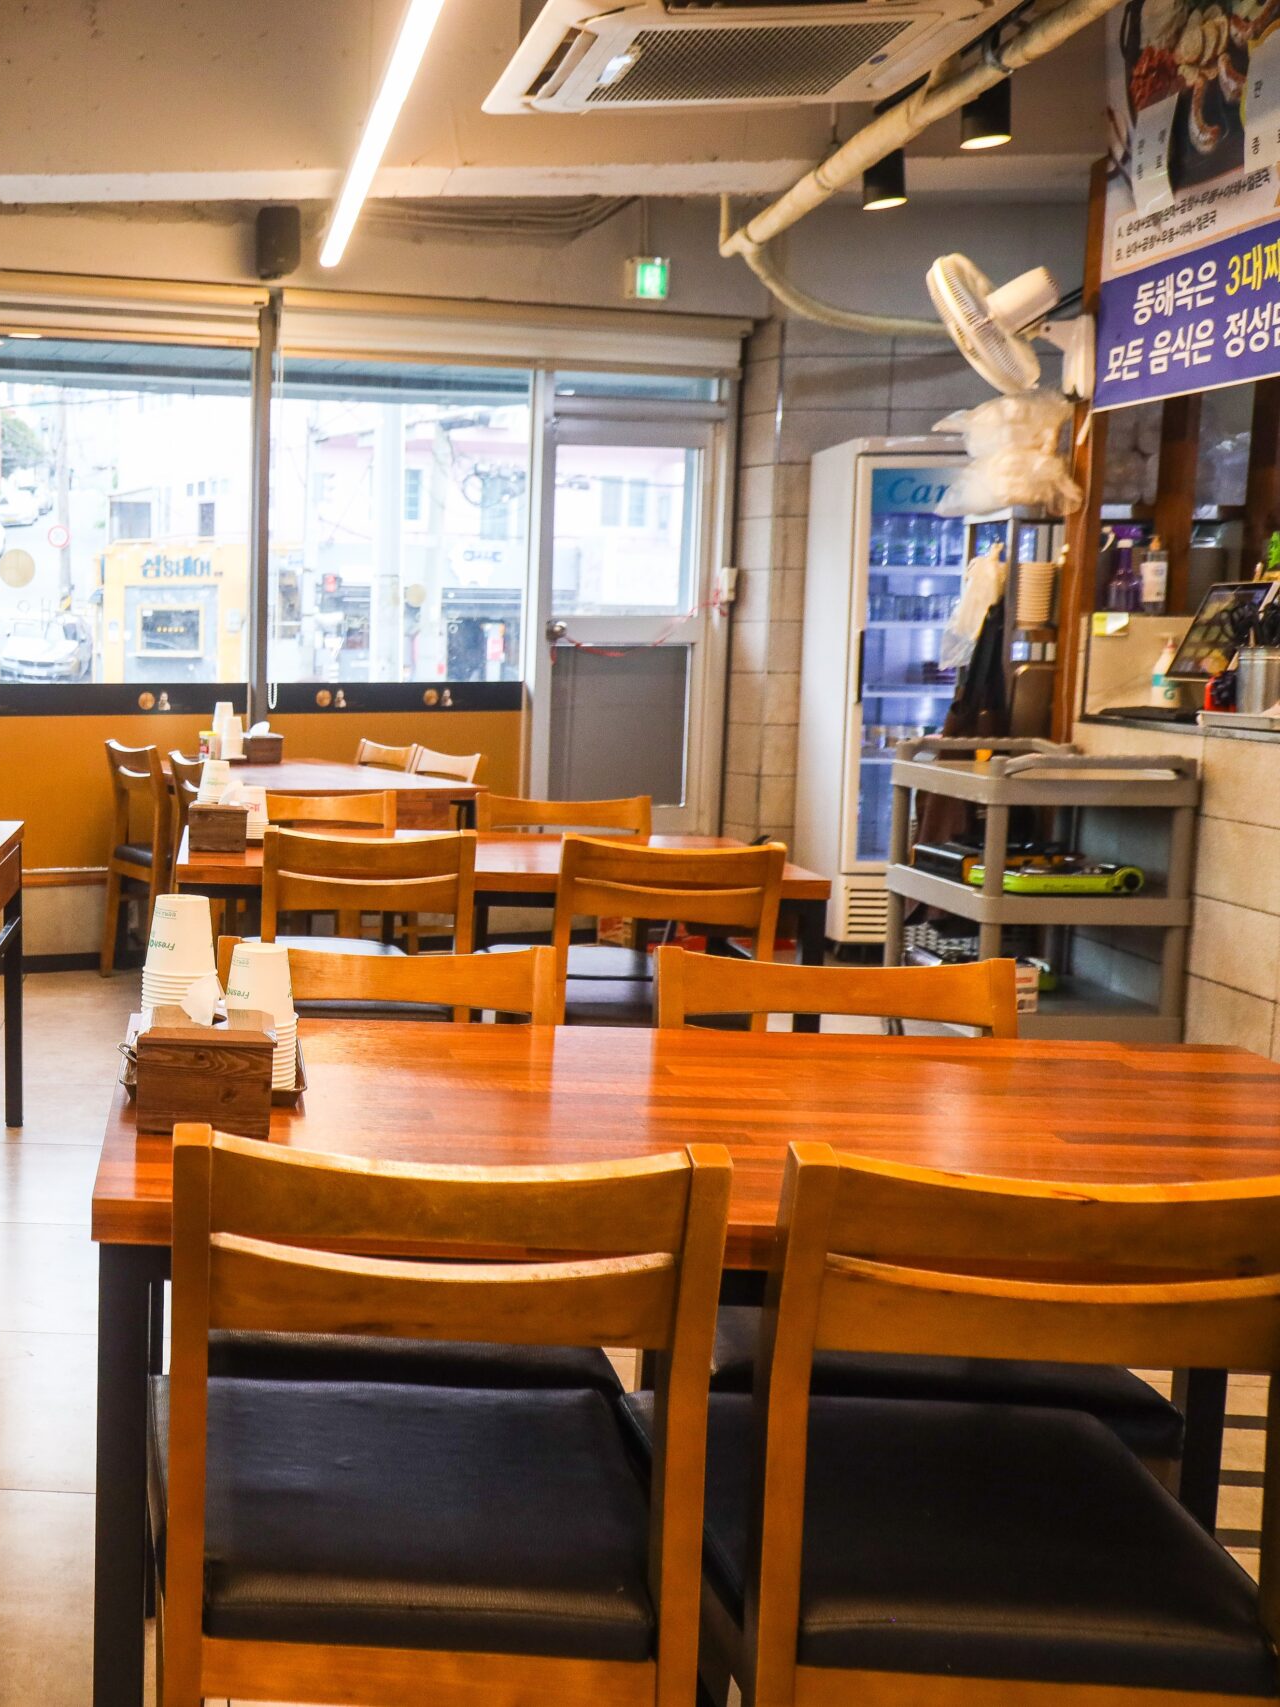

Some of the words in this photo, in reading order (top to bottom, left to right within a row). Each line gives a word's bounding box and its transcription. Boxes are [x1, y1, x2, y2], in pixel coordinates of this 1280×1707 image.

[1133, 260, 1217, 325] 동해옥은
[1103, 337, 1144, 382] 모든
[1148, 318, 1215, 375] 음식은
[888, 477, 951, 504] Car
[225, 987, 251, 1000] Fresh
